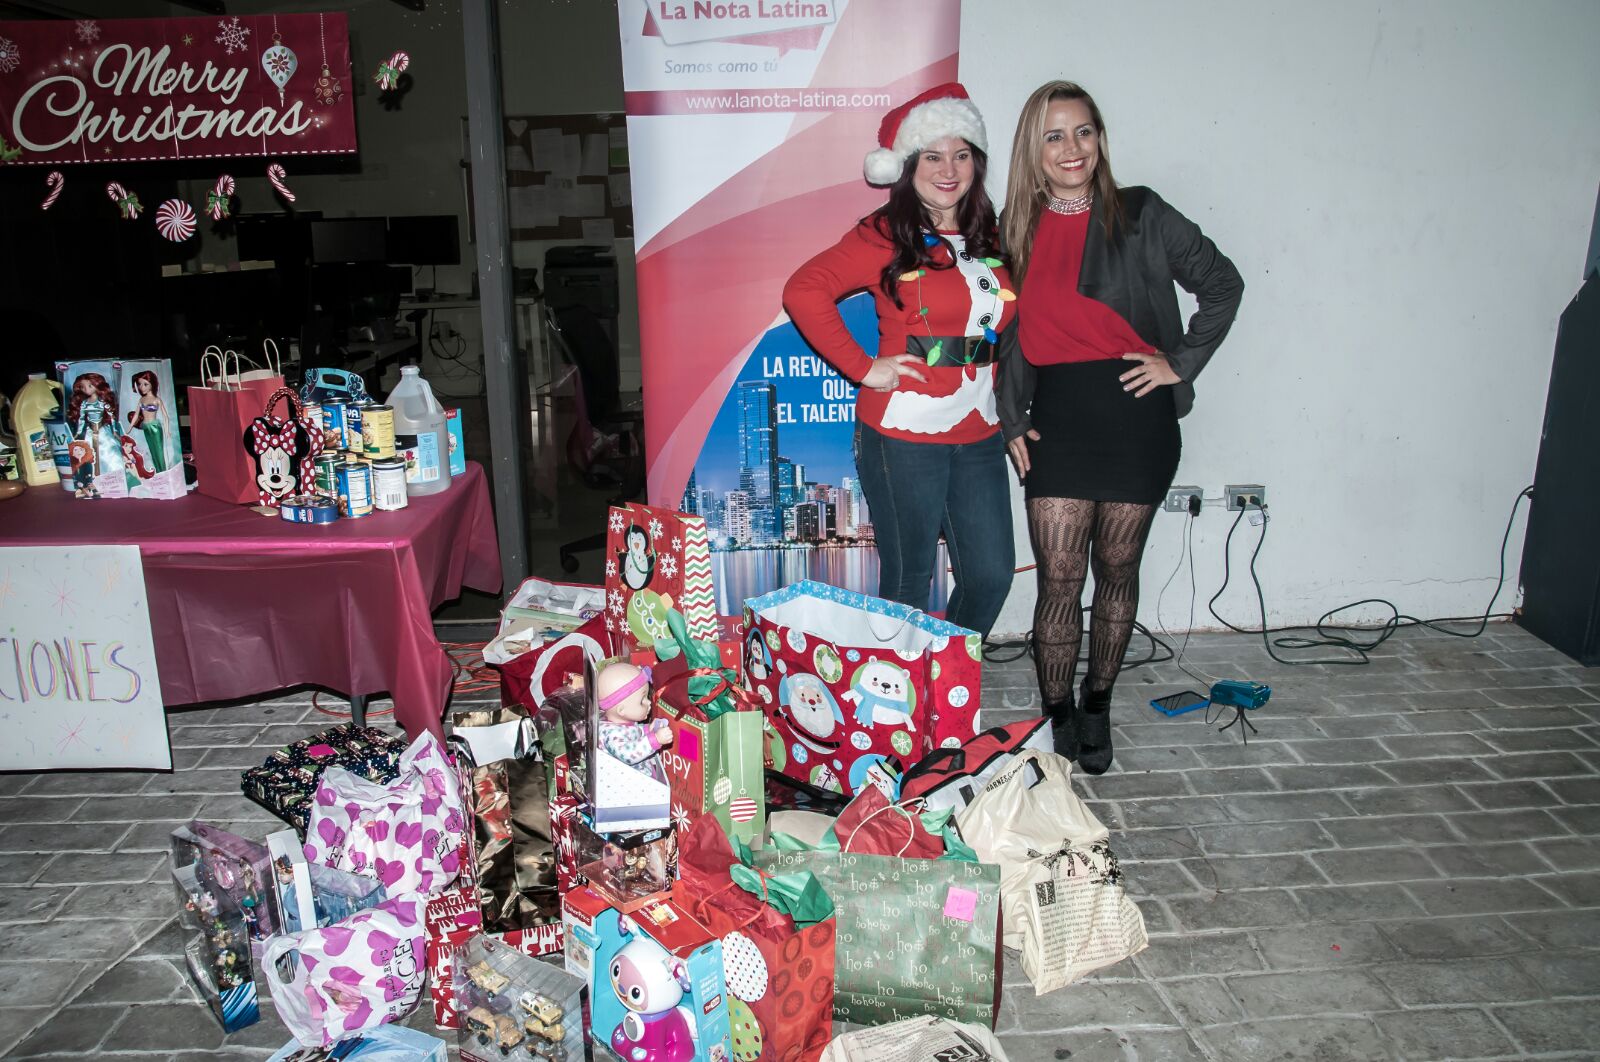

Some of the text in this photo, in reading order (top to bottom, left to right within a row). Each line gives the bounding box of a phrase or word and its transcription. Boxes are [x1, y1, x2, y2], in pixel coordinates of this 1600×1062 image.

[660, 0, 828, 20] La Nota Latina
[93, 43, 248, 104] Merry
[664, 59, 778, 75] Somos como tú
[686, 91, 891, 110] www.lanota-latina.com
[12, 75, 312, 152] Christmas
[763, 356, 785, 378] LA
[822, 379, 855, 401] QUE
[777, 403, 797, 424] EL
[662, 749, 691, 780] ppy
[839, 852, 857, 867] ho
[902, 857, 918, 874] ho
[963, 862, 982, 877] ho
[851, 872, 868, 893] ho
[915, 880, 934, 895] ho
[883, 901, 900, 917] ho
[896, 932, 913, 954] ho
[958, 942, 976, 958] ho
[846, 951, 862, 972] ho
[911, 960, 928, 976] ho
[971, 963, 987, 985] ho
[878, 981, 895, 996] ho
[937, 987, 953, 1006] ho
